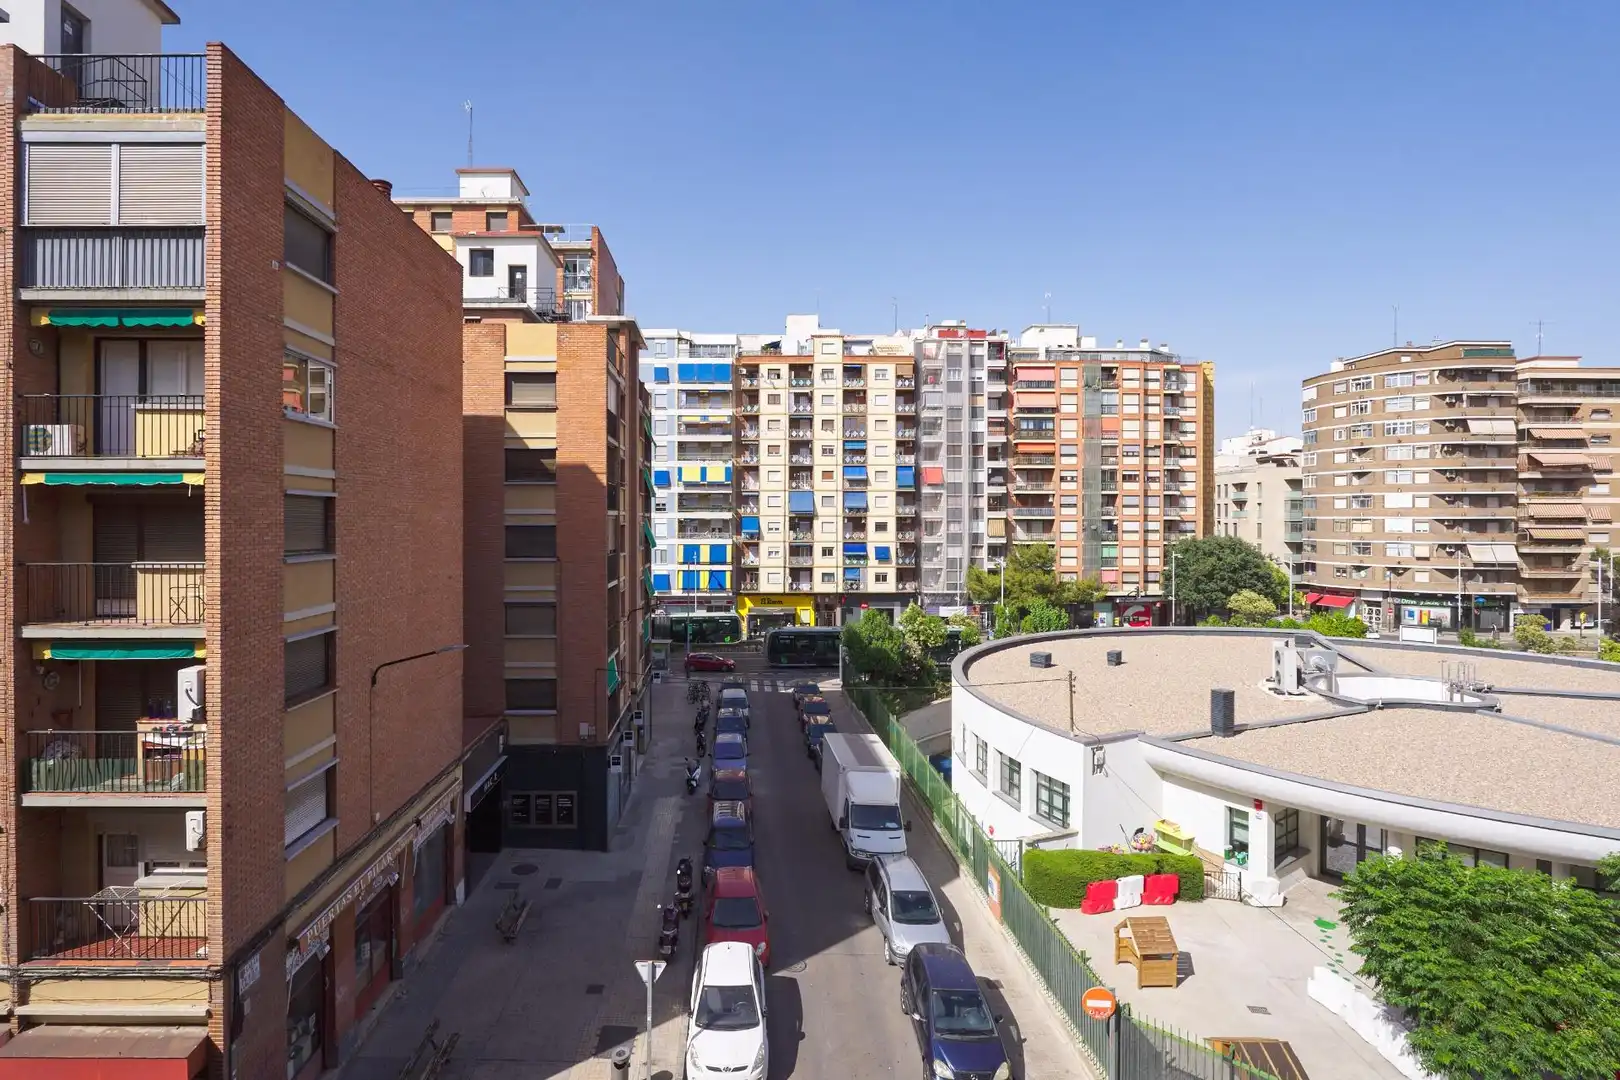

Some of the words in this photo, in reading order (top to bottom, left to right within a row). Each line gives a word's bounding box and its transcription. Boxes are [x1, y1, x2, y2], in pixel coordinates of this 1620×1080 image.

[306, 893, 352, 943] PUERTAS
[354, 880, 366, 895] EL
[367, 853, 393, 882] PILAR
